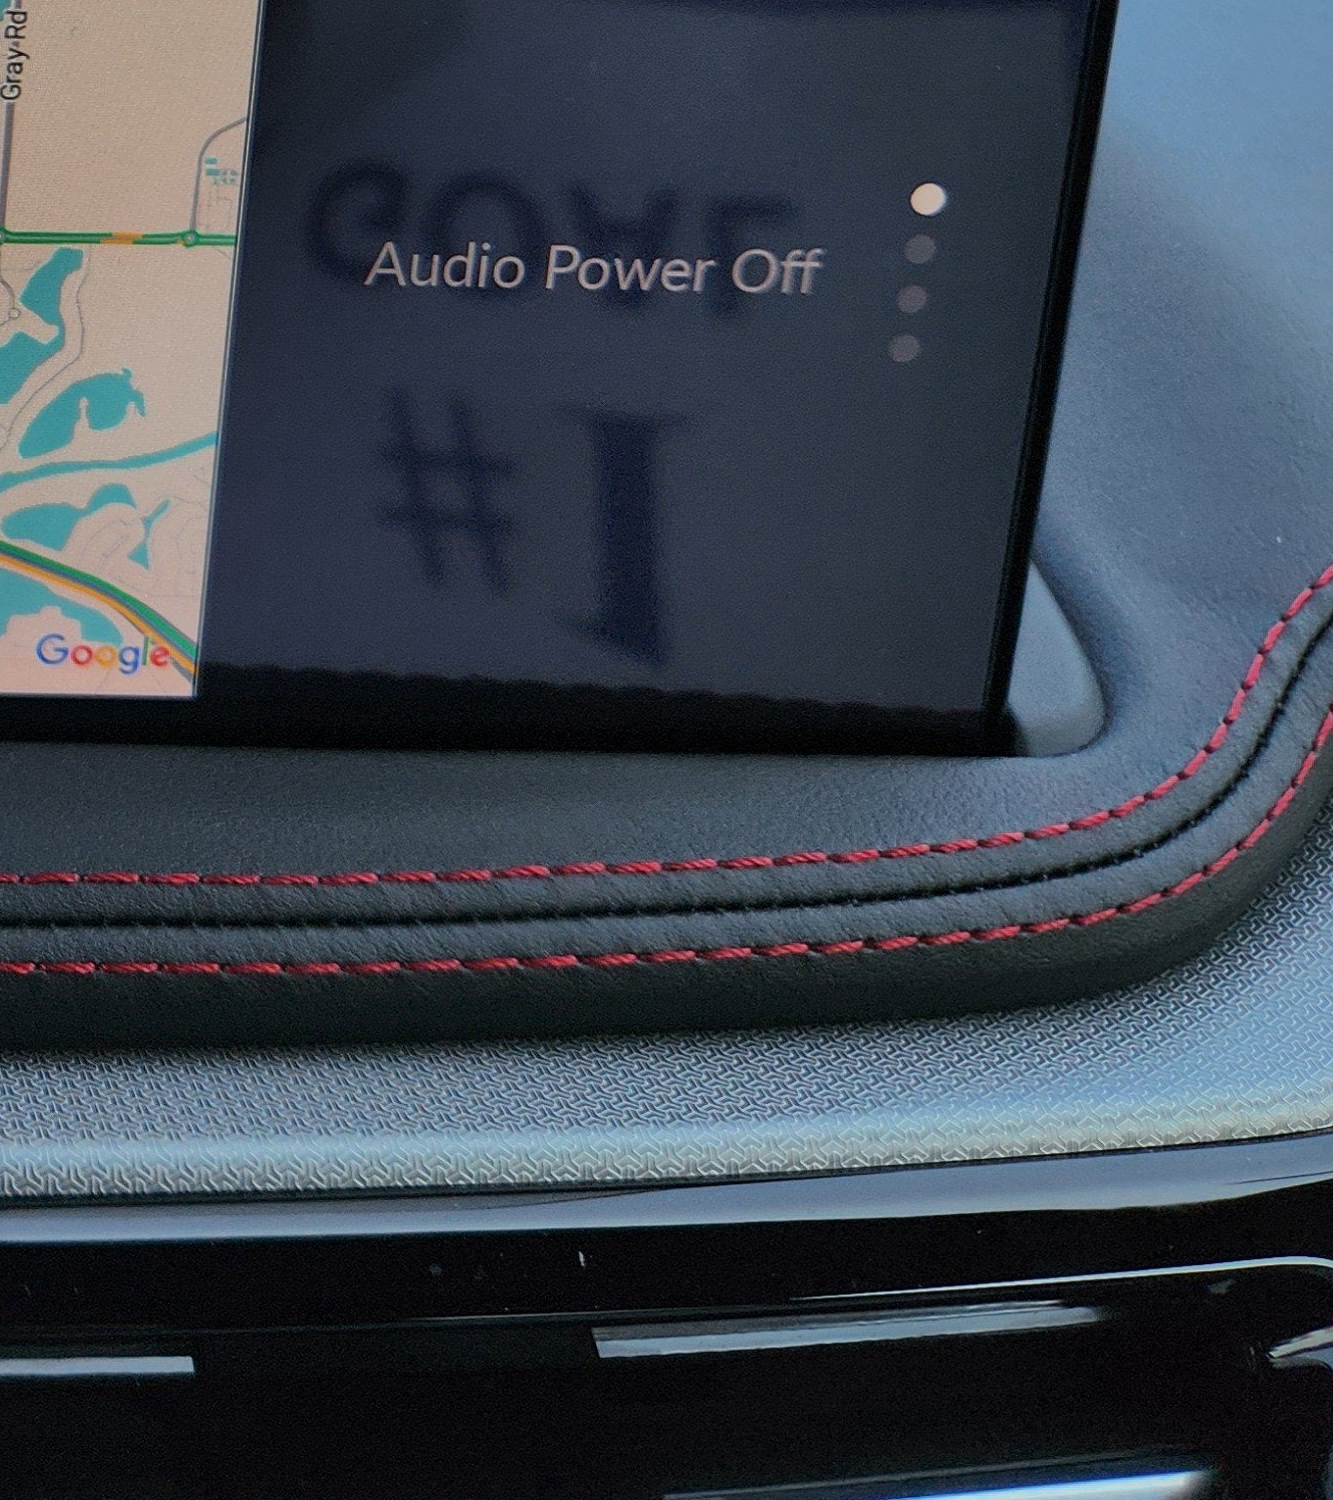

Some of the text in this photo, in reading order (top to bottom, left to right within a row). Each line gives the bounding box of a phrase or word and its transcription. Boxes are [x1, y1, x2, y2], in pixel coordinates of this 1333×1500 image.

[0, 10, 30, 100] Gray Rd
[364, 240, 827, 295] Audio Power Off
[36, 633, 171, 675] Google
